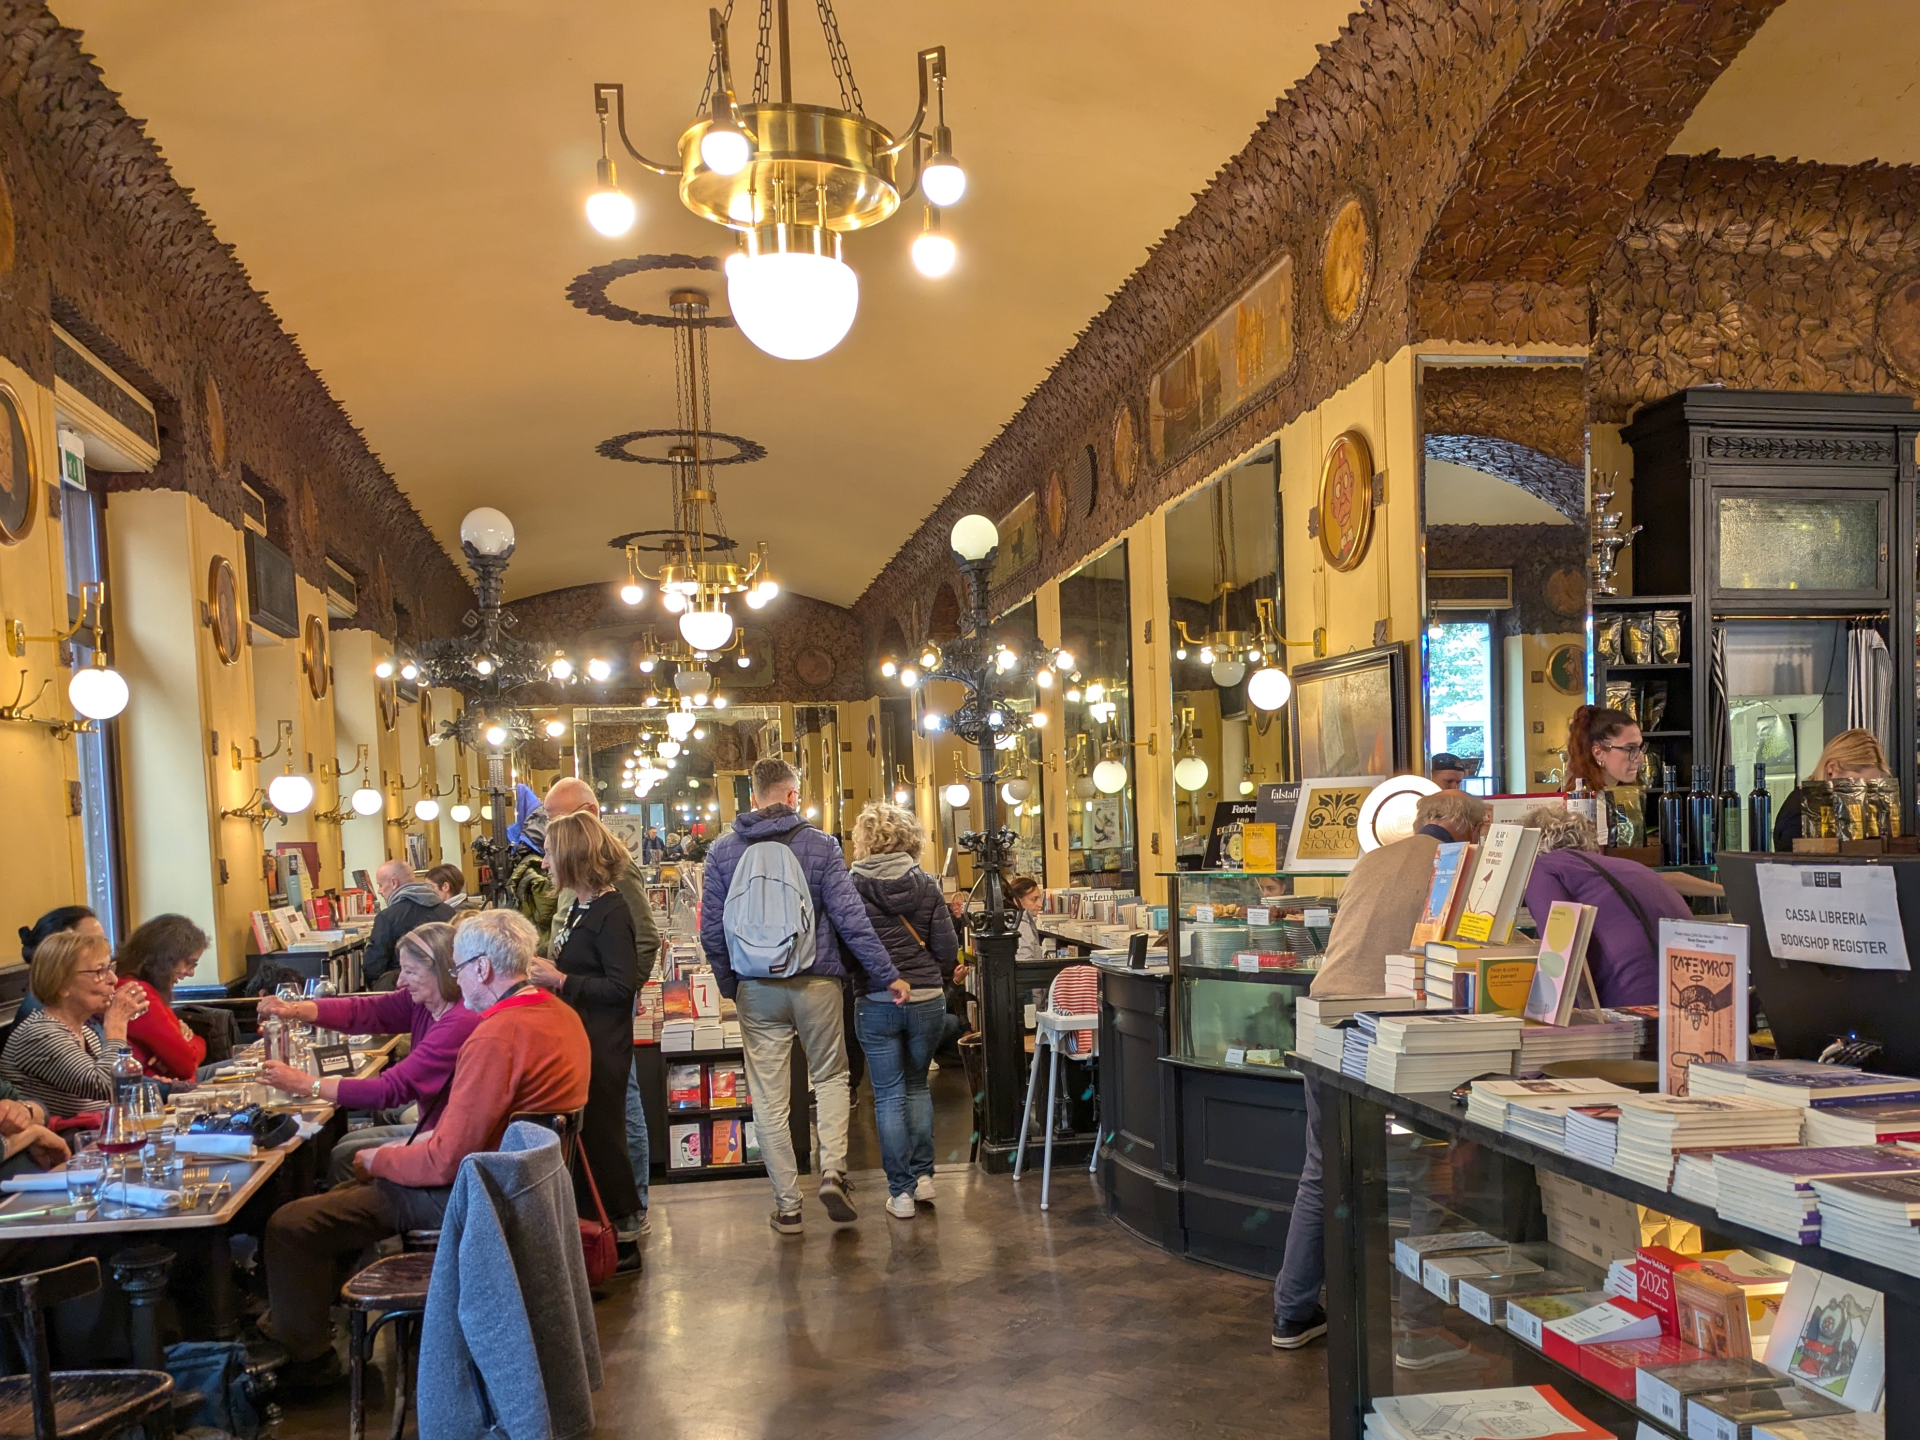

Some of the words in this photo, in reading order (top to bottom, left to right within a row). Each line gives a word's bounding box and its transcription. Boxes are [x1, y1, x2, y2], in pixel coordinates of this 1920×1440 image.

[1231, 804, 1257, 814] Forbes
[1303, 839, 1355, 851] STORICO
[1785, 908, 1817, 923] CASSA
[1819, 911, 1867, 926] LIBRERIA
[1781, 933, 1829, 950] BOOKSHOP
[1833, 938, 1888, 955] REGISTER
[1639, 1267, 1669, 1300] 2025
